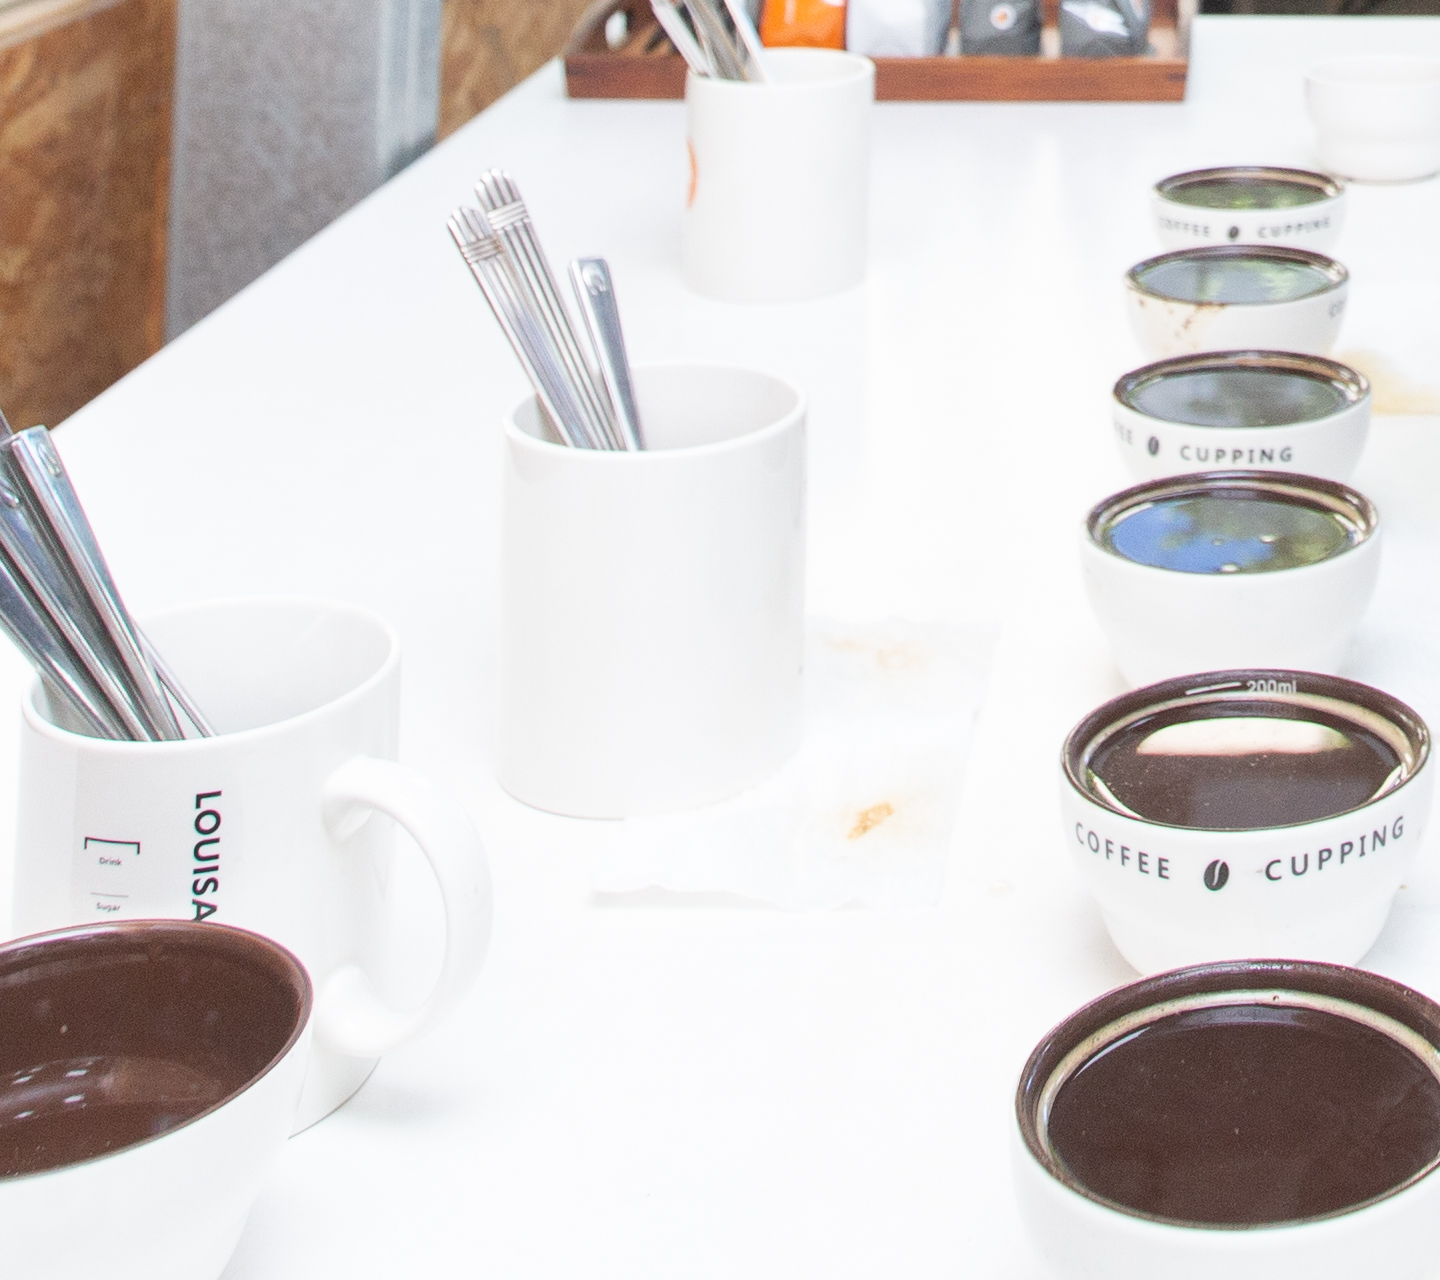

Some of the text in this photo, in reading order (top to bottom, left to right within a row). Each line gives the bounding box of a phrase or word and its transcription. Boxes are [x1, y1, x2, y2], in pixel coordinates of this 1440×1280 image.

[1258, 216, 1331, 238] CUPPING
[1179, 444, 1294, 464] CUPPING
[1246, 679, 1298, 694] 200ml
[191, 790, 222, 923] LOUISA
[1074, 814, 1405, 881] COFFEE CUPPING
[98, 856, 122, 867] Drink
[96, 901, 121, 913] Sugar
